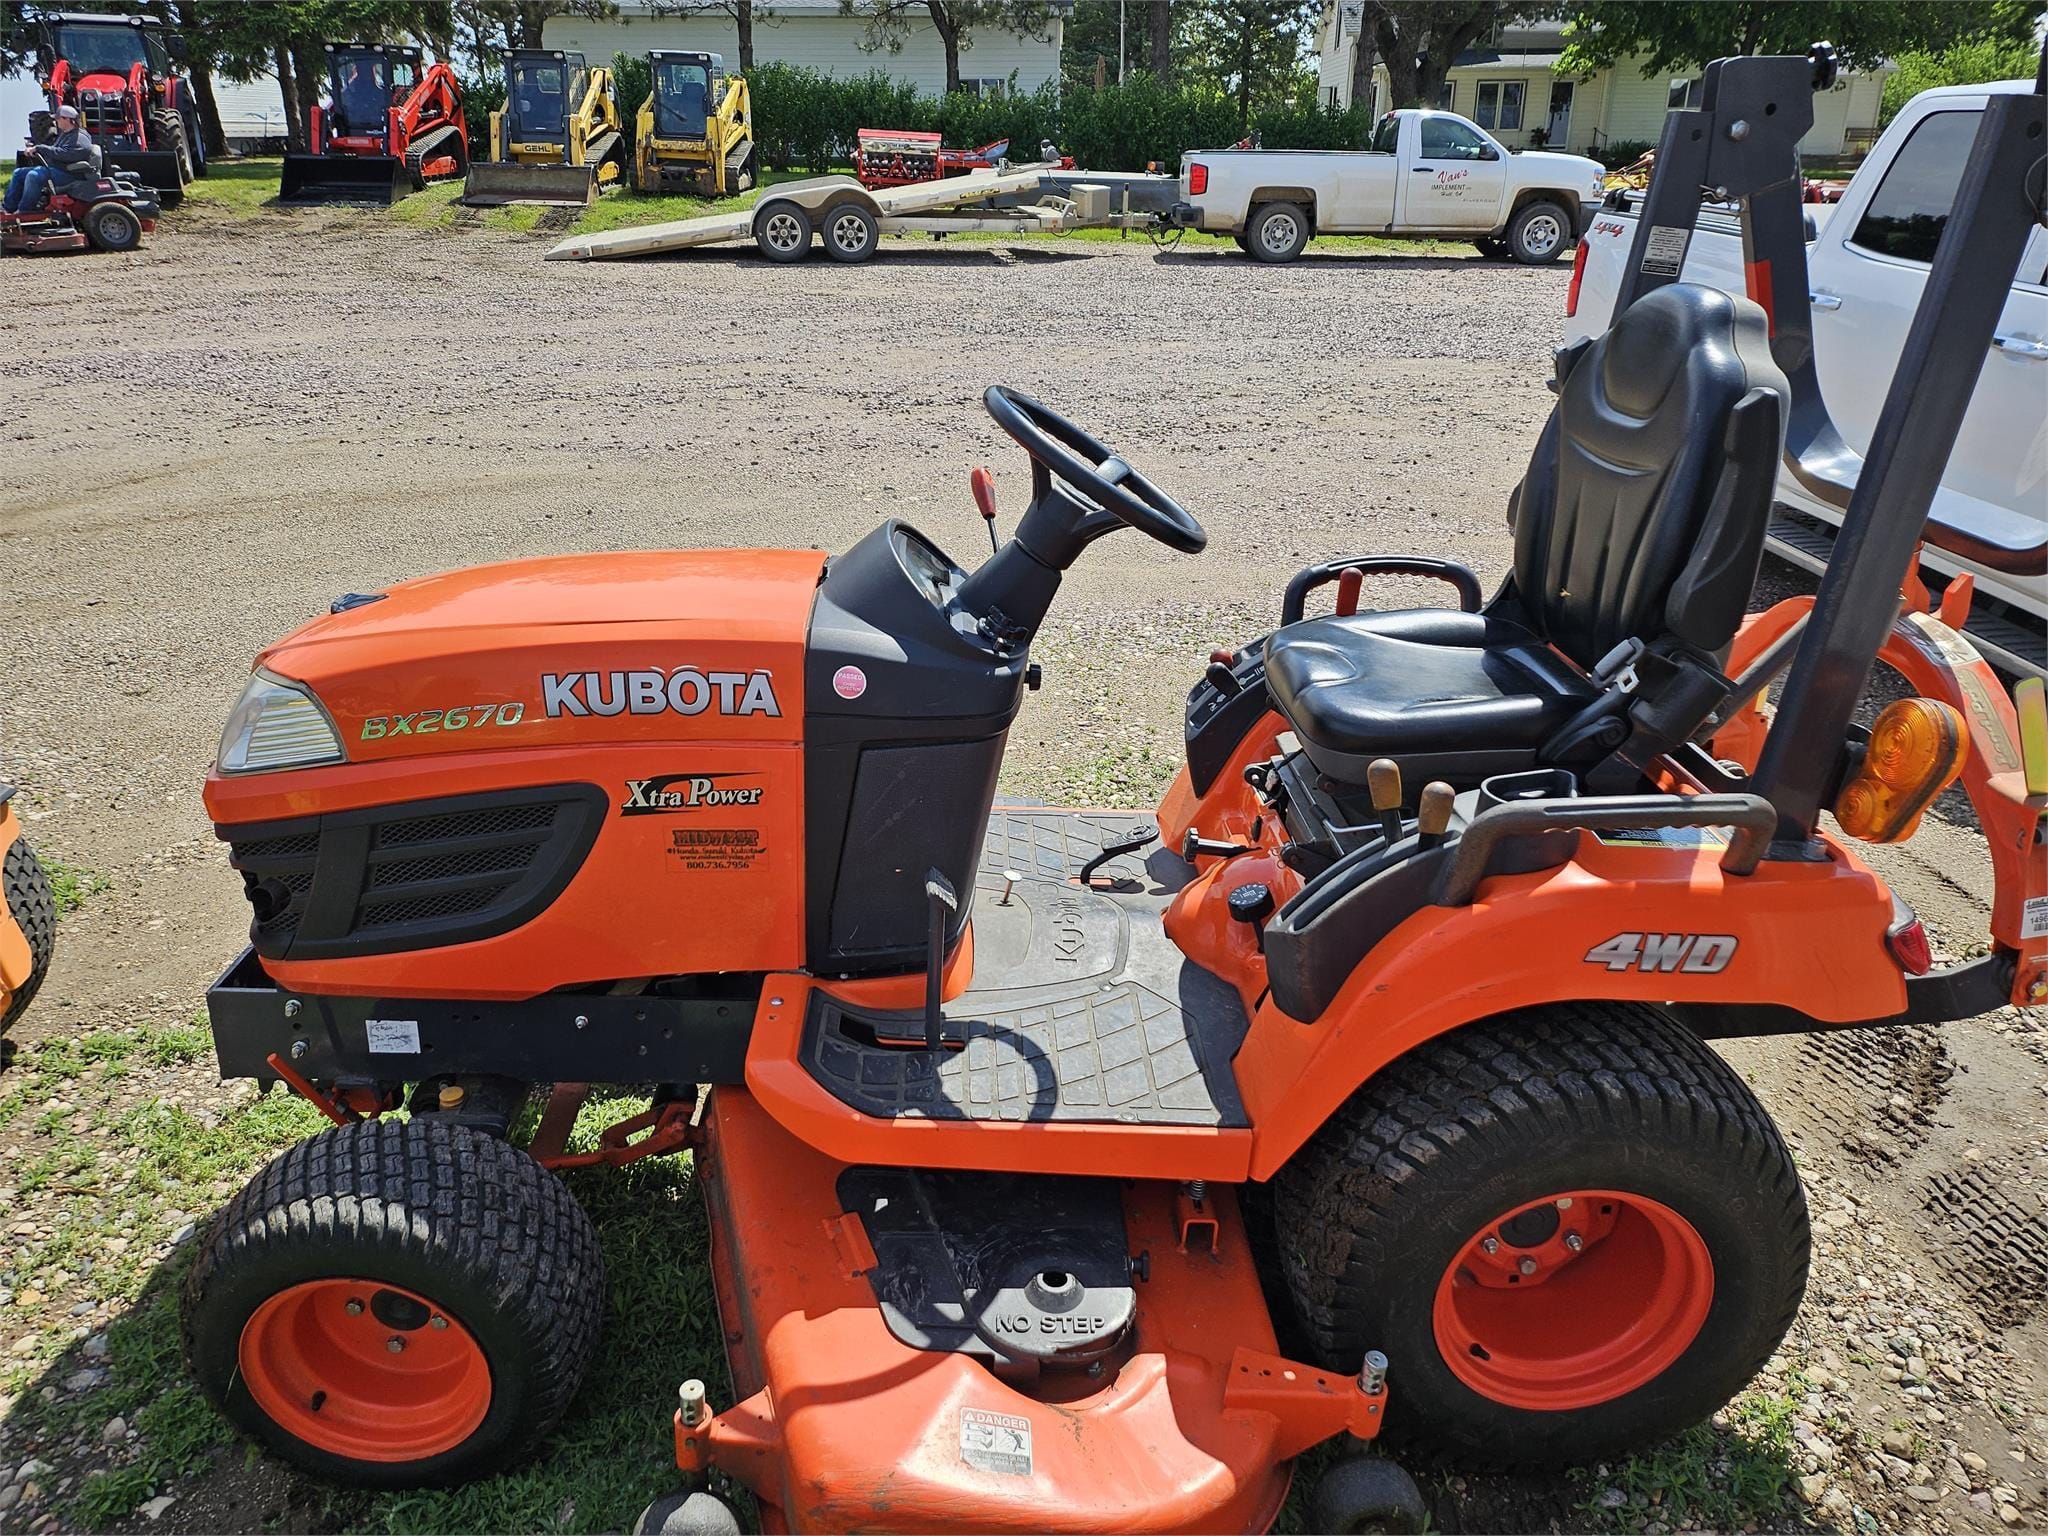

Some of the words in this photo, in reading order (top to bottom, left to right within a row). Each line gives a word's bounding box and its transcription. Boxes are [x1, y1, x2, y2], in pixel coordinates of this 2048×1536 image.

[524, 144, 551, 153] GEHL
[1437, 169, 1469, 184] Van's
[542, 670, 783, 718] KUBOTA
[360, 702, 525, 741] BX2670
[621, 779, 683, 808] Xtra
[686, 777, 763, 807] Power
[672, 829, 759, 847] MIDWEST
[687, 861, 750, 869] 800.736.7956
[1583, 931, 1740, 975] 4WD
[995, 1314, 1033, 1334] NO
[1039, 1314, 1106, 1335] STEP
[975, 1411, 1028, 1430] DANGER
